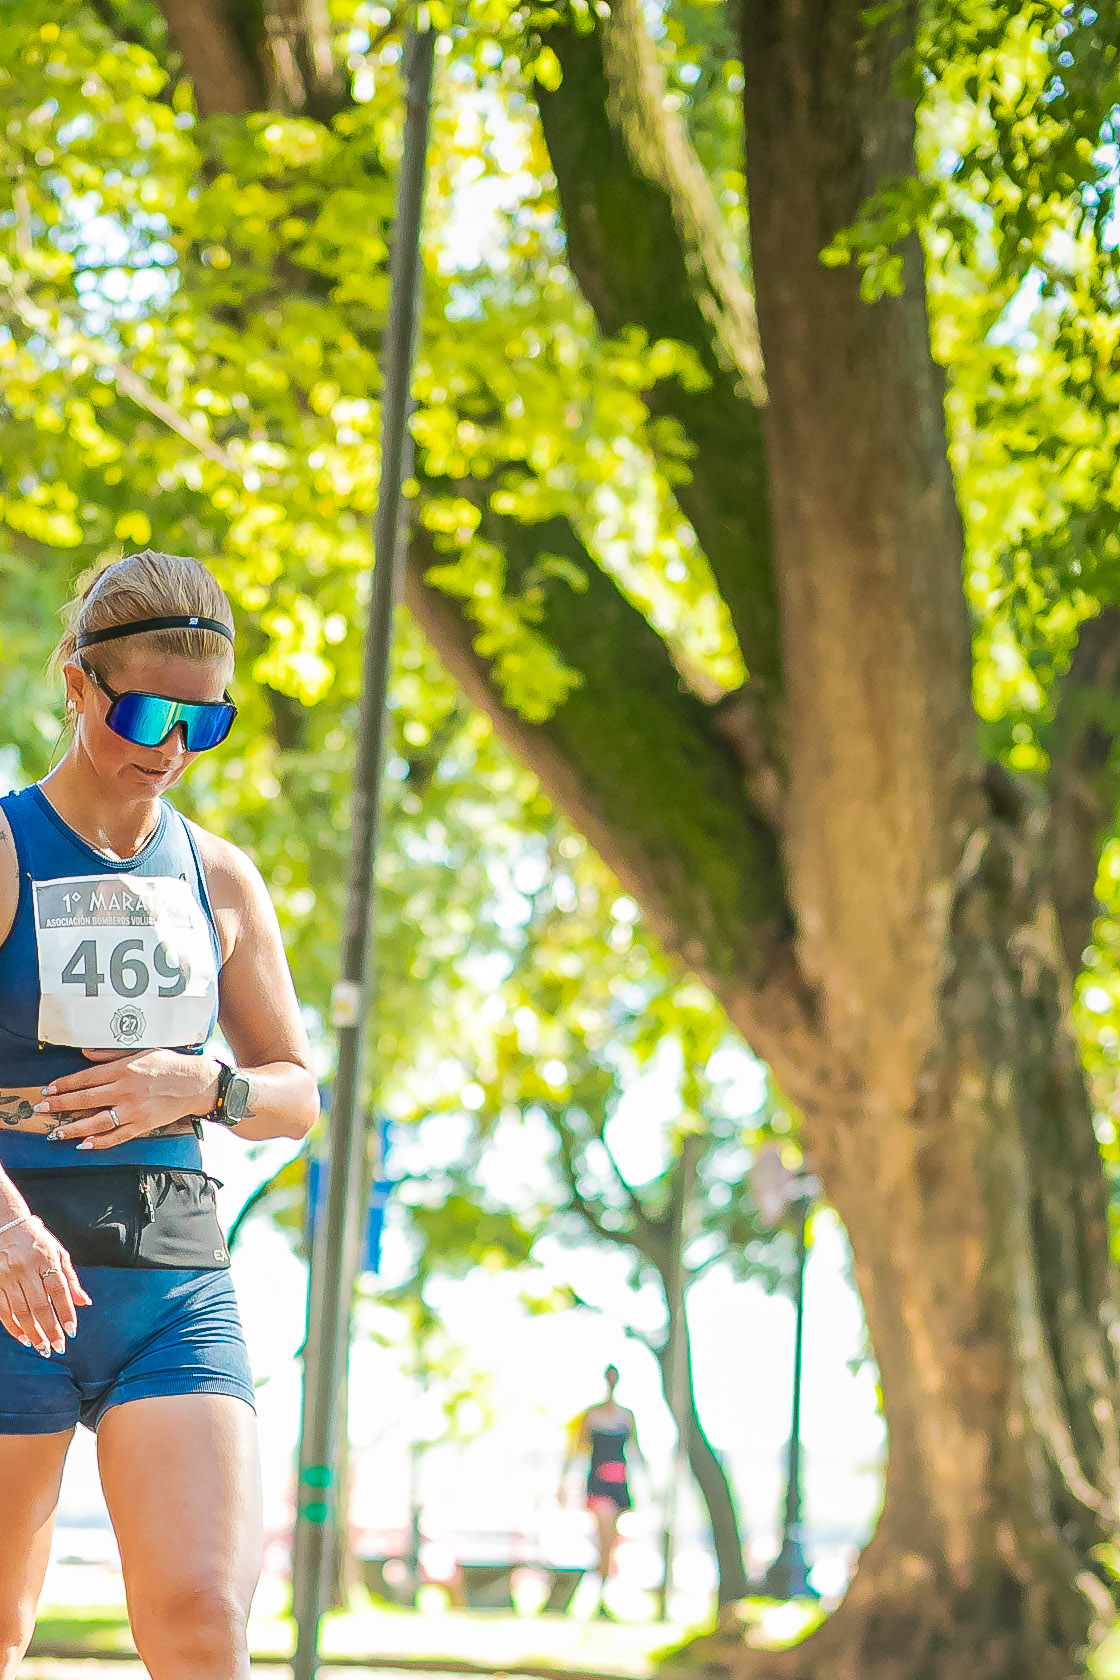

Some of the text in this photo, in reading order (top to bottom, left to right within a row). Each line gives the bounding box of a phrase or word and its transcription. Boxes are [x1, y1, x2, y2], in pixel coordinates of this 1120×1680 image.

[89, 890, 153, 912] MARA
[46, 915, 91, 928] ASOCIACIÓN
[92, 916, 130, 927] BOMBEROS
[61, 939, 191, 998] 469
[121, 1016, 137, 1032] 27
